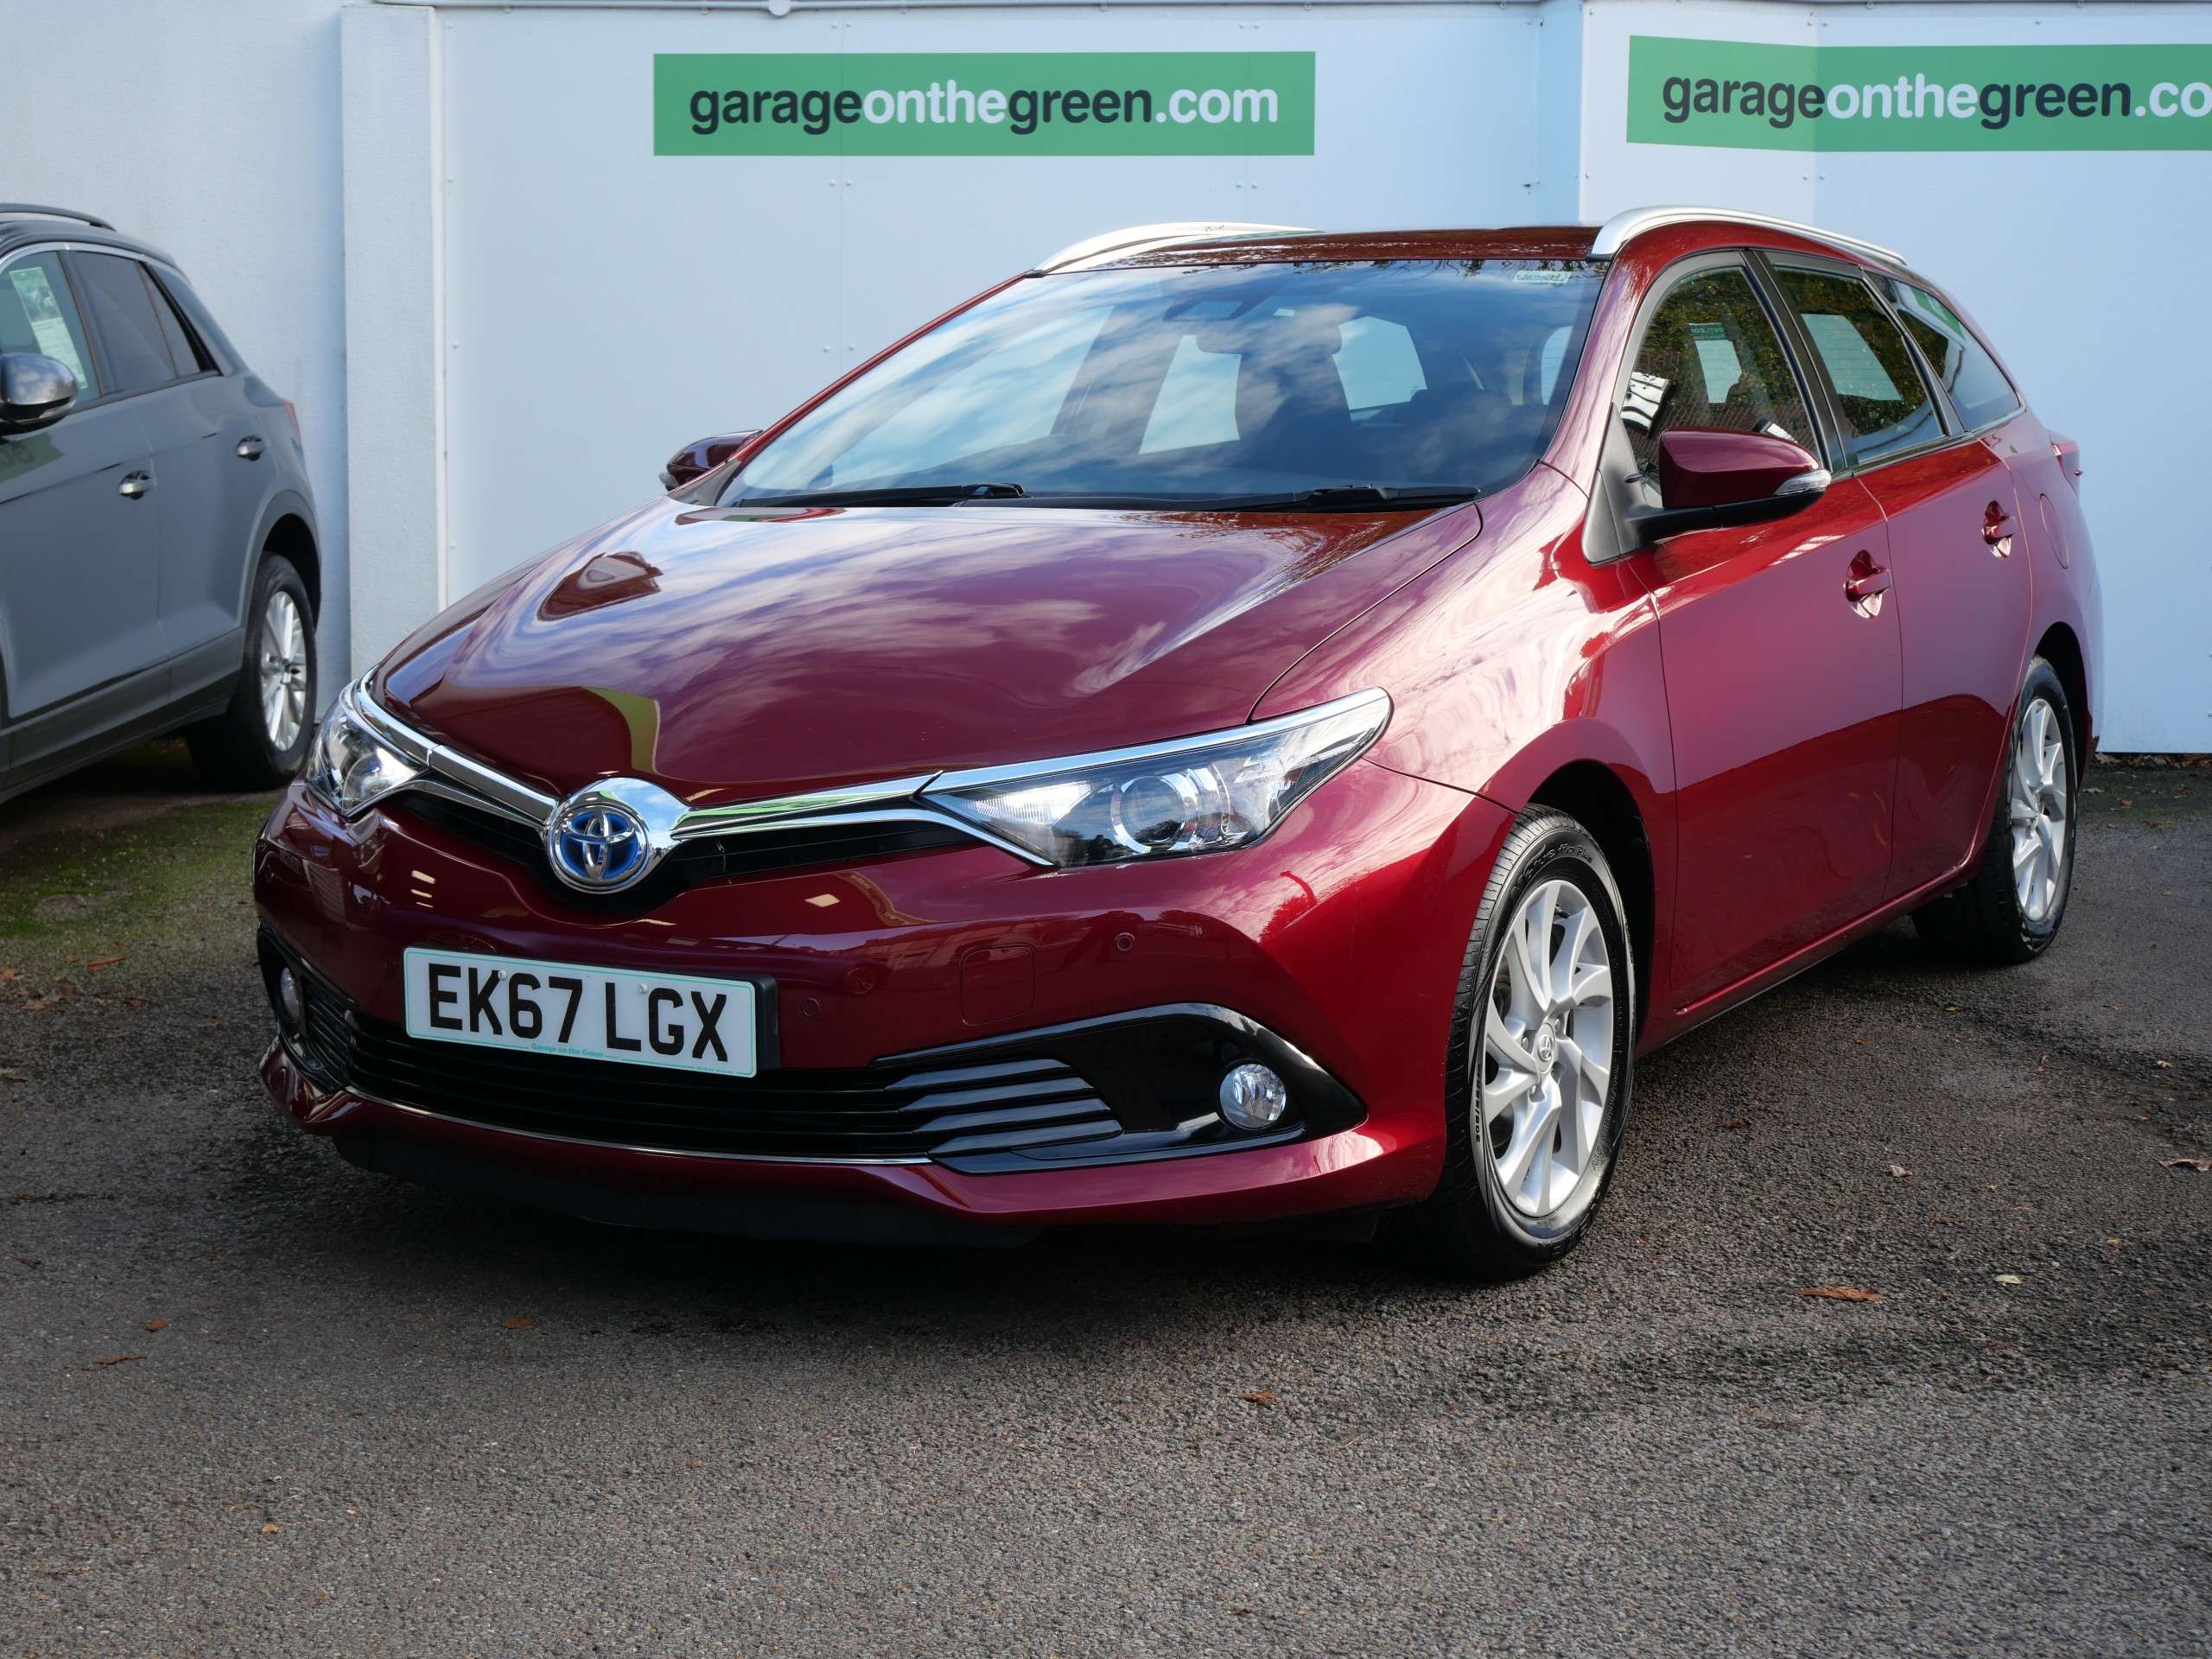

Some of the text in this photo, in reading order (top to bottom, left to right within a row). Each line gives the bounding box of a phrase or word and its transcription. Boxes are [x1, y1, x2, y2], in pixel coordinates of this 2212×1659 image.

[690, 79, 1278, 136] garageonthegreen.com
[428, 963, 728, 1063] EK67 LGX
